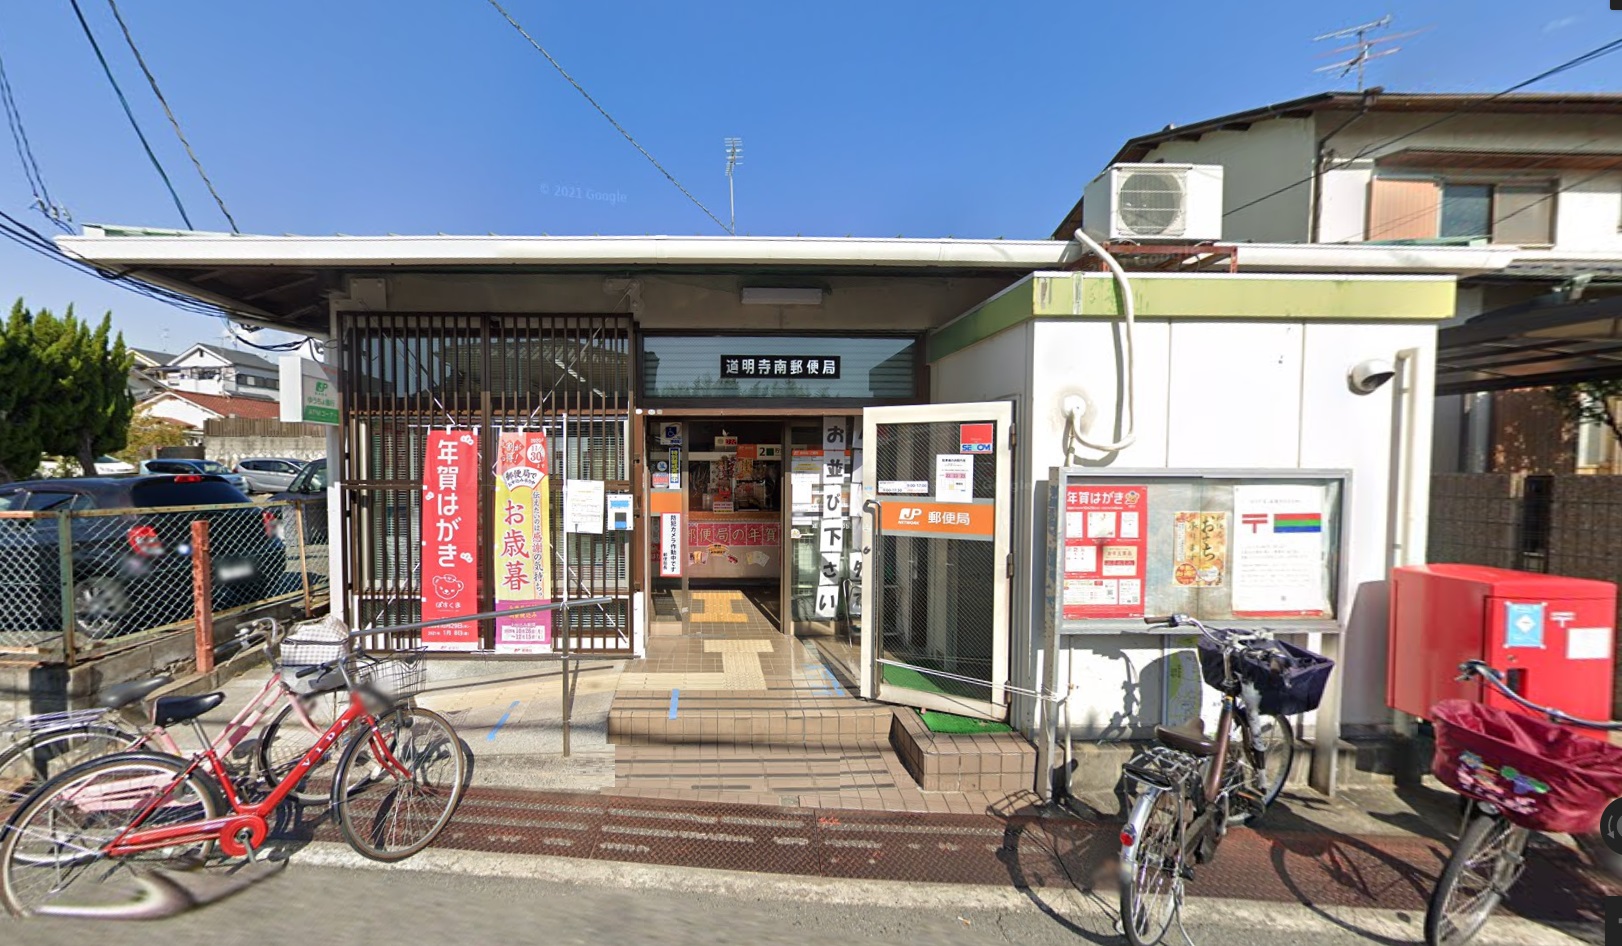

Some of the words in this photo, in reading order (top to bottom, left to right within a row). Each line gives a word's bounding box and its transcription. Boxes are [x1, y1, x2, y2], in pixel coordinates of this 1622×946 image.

[726, 359, 836, 375] 道明寺南郵便局
[759, 447, 766, 457] 2
[505, 469, 537, 481] 郵便局で
[436, 439, 462, 568] 年賀はがき
[1067, 491, 1124, 505] 年賀はがき
[819, 425, 844, 611] お並び下さい
[928, 511, 971, 526] 郵便局
[501, 499, 530, 591] お歳暮
[435, 601, 461, 609] ぽすくま
[301, 719, 350, 766] VIDA
